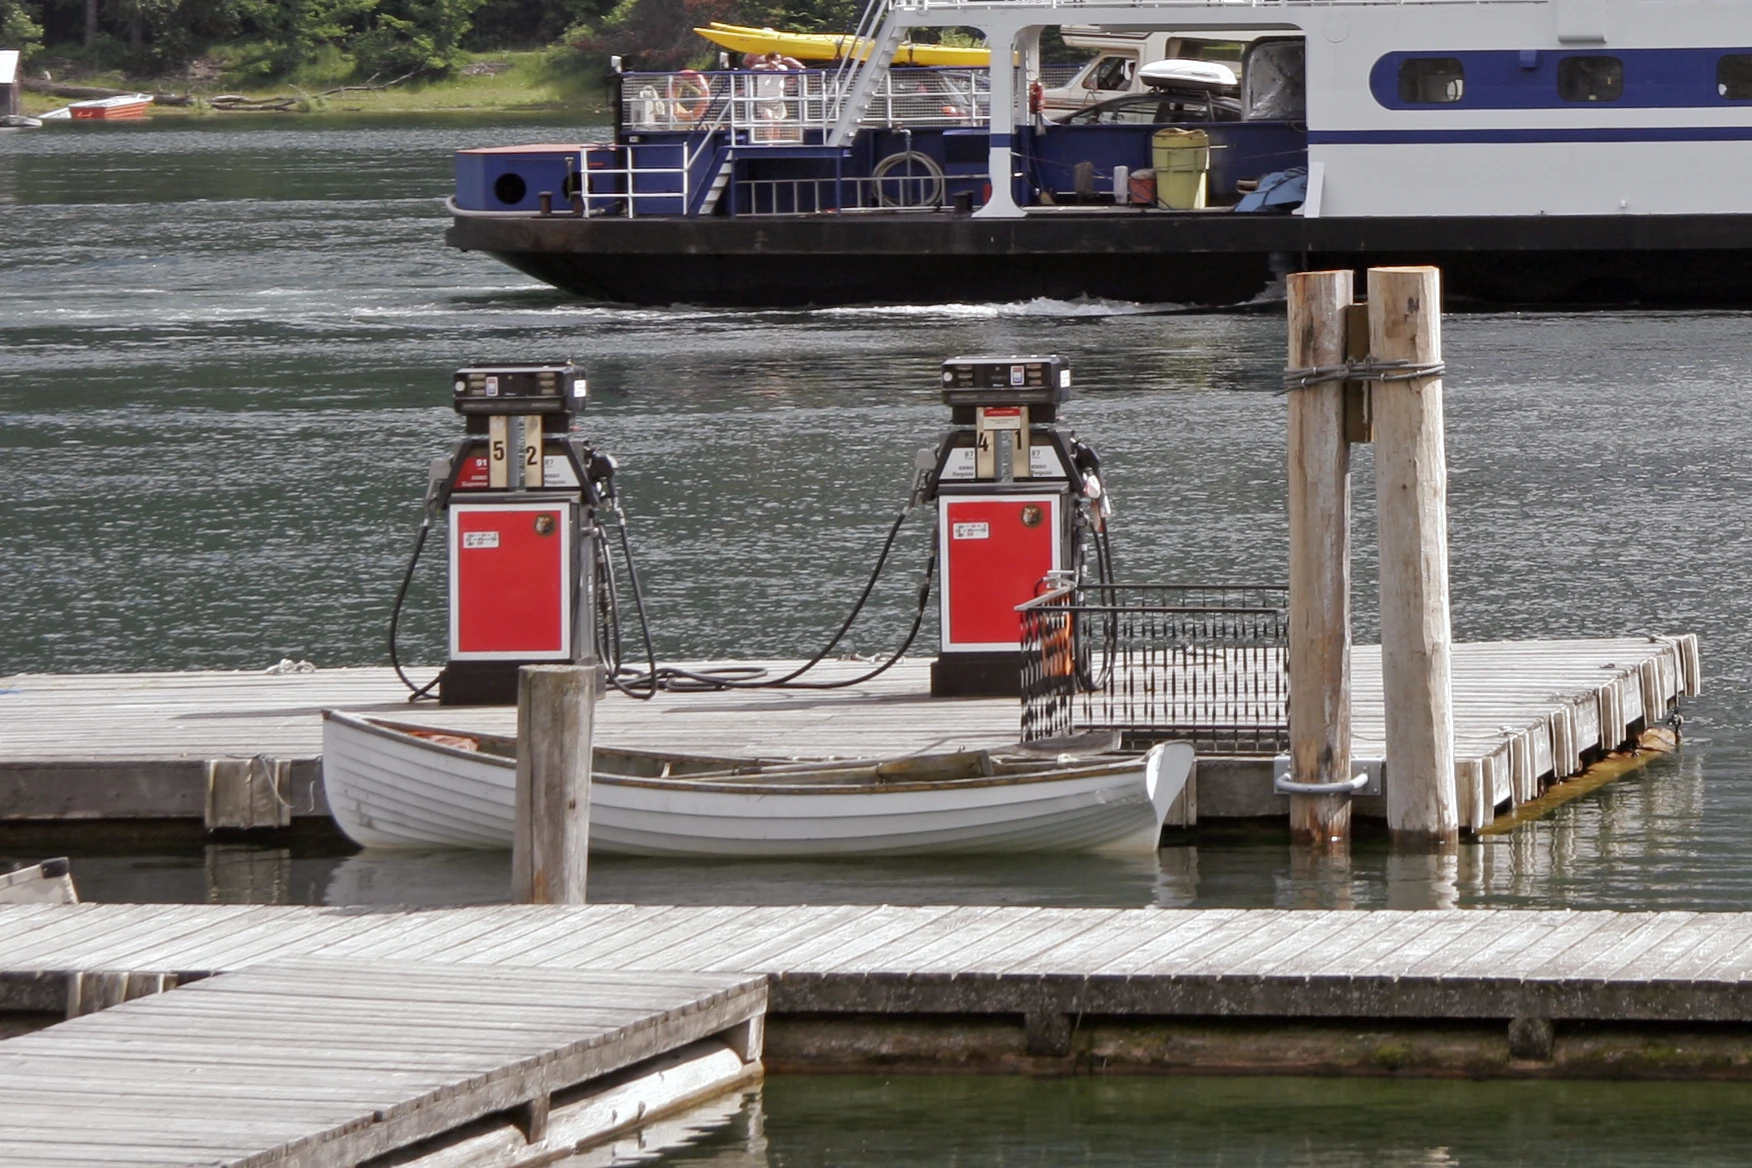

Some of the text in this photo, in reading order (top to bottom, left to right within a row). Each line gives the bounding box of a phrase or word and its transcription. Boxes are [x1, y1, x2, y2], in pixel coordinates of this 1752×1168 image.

[493, 440, 504, 461] 5
[977, 432, 989, 452] 4
[1014, 432, 1022, 450] 1
[475, 458, 488, 467] 91
[526, 445, 538, 466] 2
